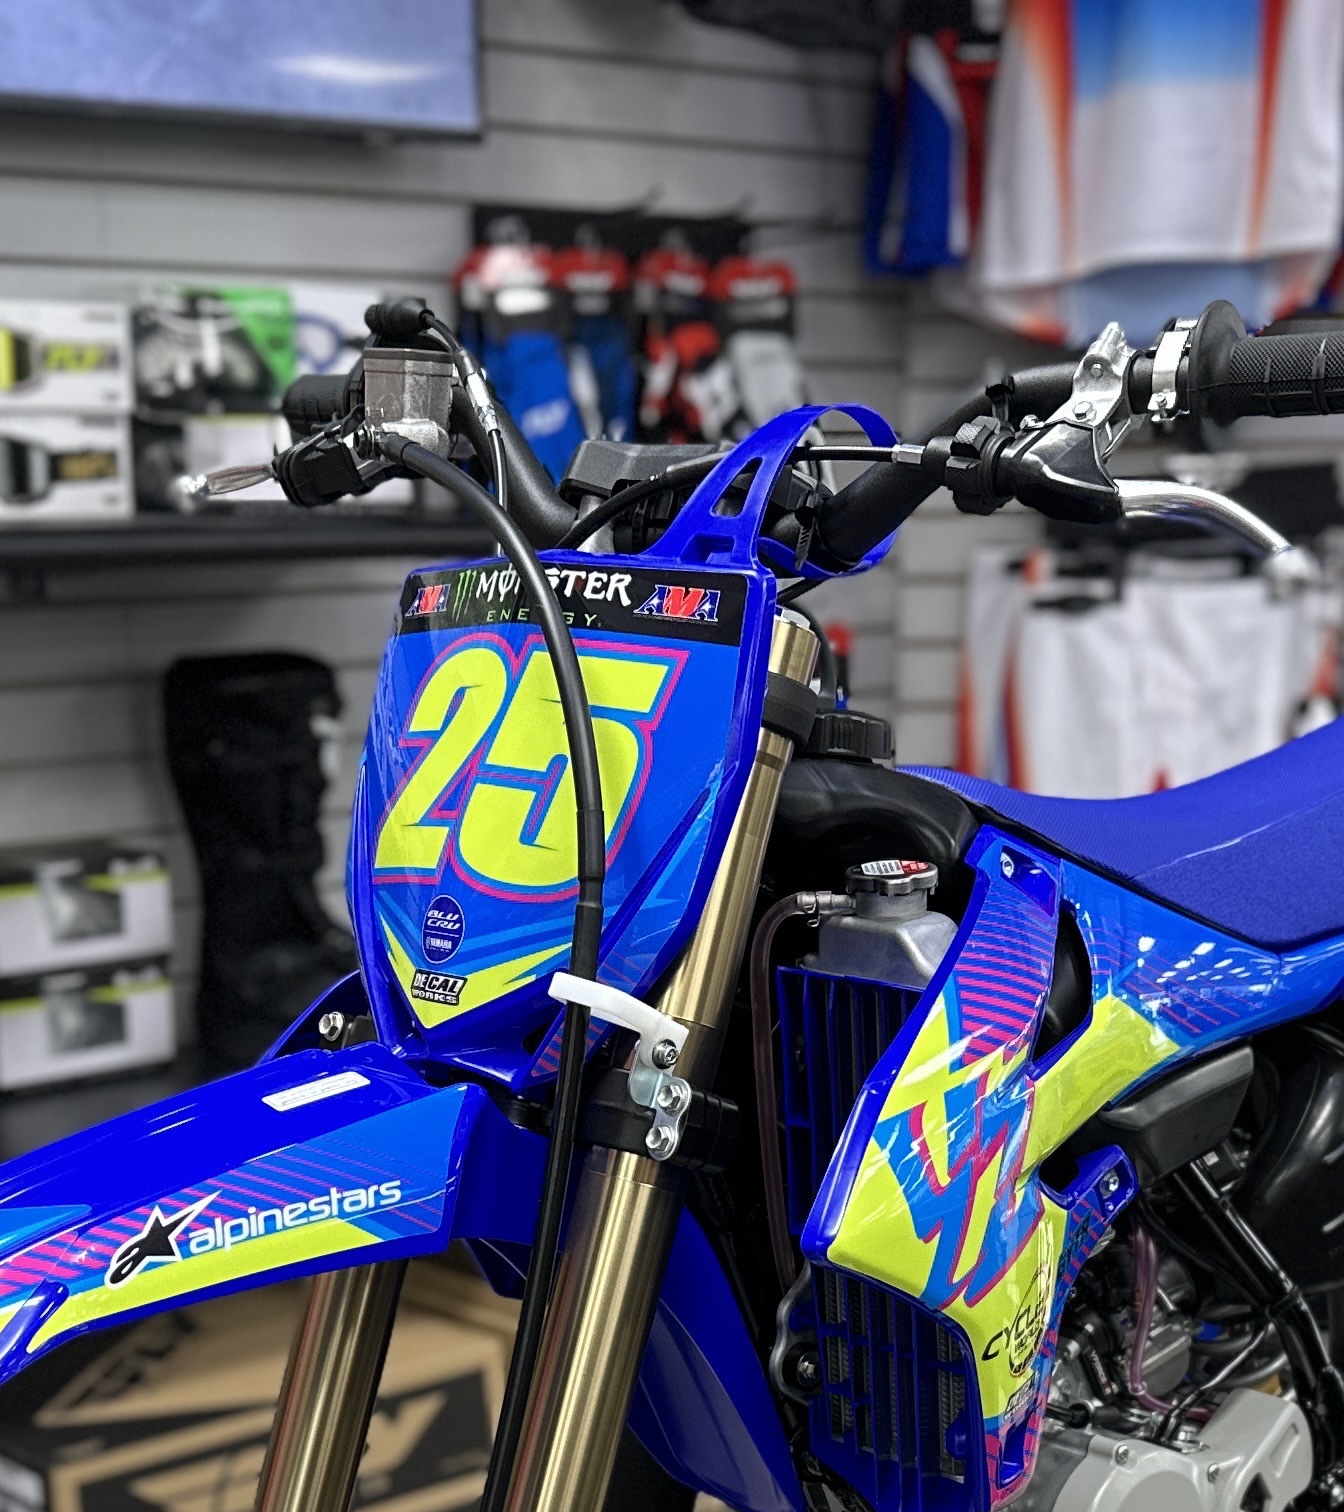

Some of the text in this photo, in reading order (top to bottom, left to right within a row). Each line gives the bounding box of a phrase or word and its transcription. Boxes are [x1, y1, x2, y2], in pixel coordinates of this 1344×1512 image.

[476, 562, 632, 607] MOSTER
[406, 585, 451, 617] AMA
[486, 607, 598, 627] ENEGY
[633, 583, 721, 622] AMA
[372, 640, 676, 892] 25
[427, 909, 460, 921] BLU
[427, 918, 461, 930] CRU
[413, 972, 465, 996] DECAL
[188, 1179, 403, 1253] alpinestars
